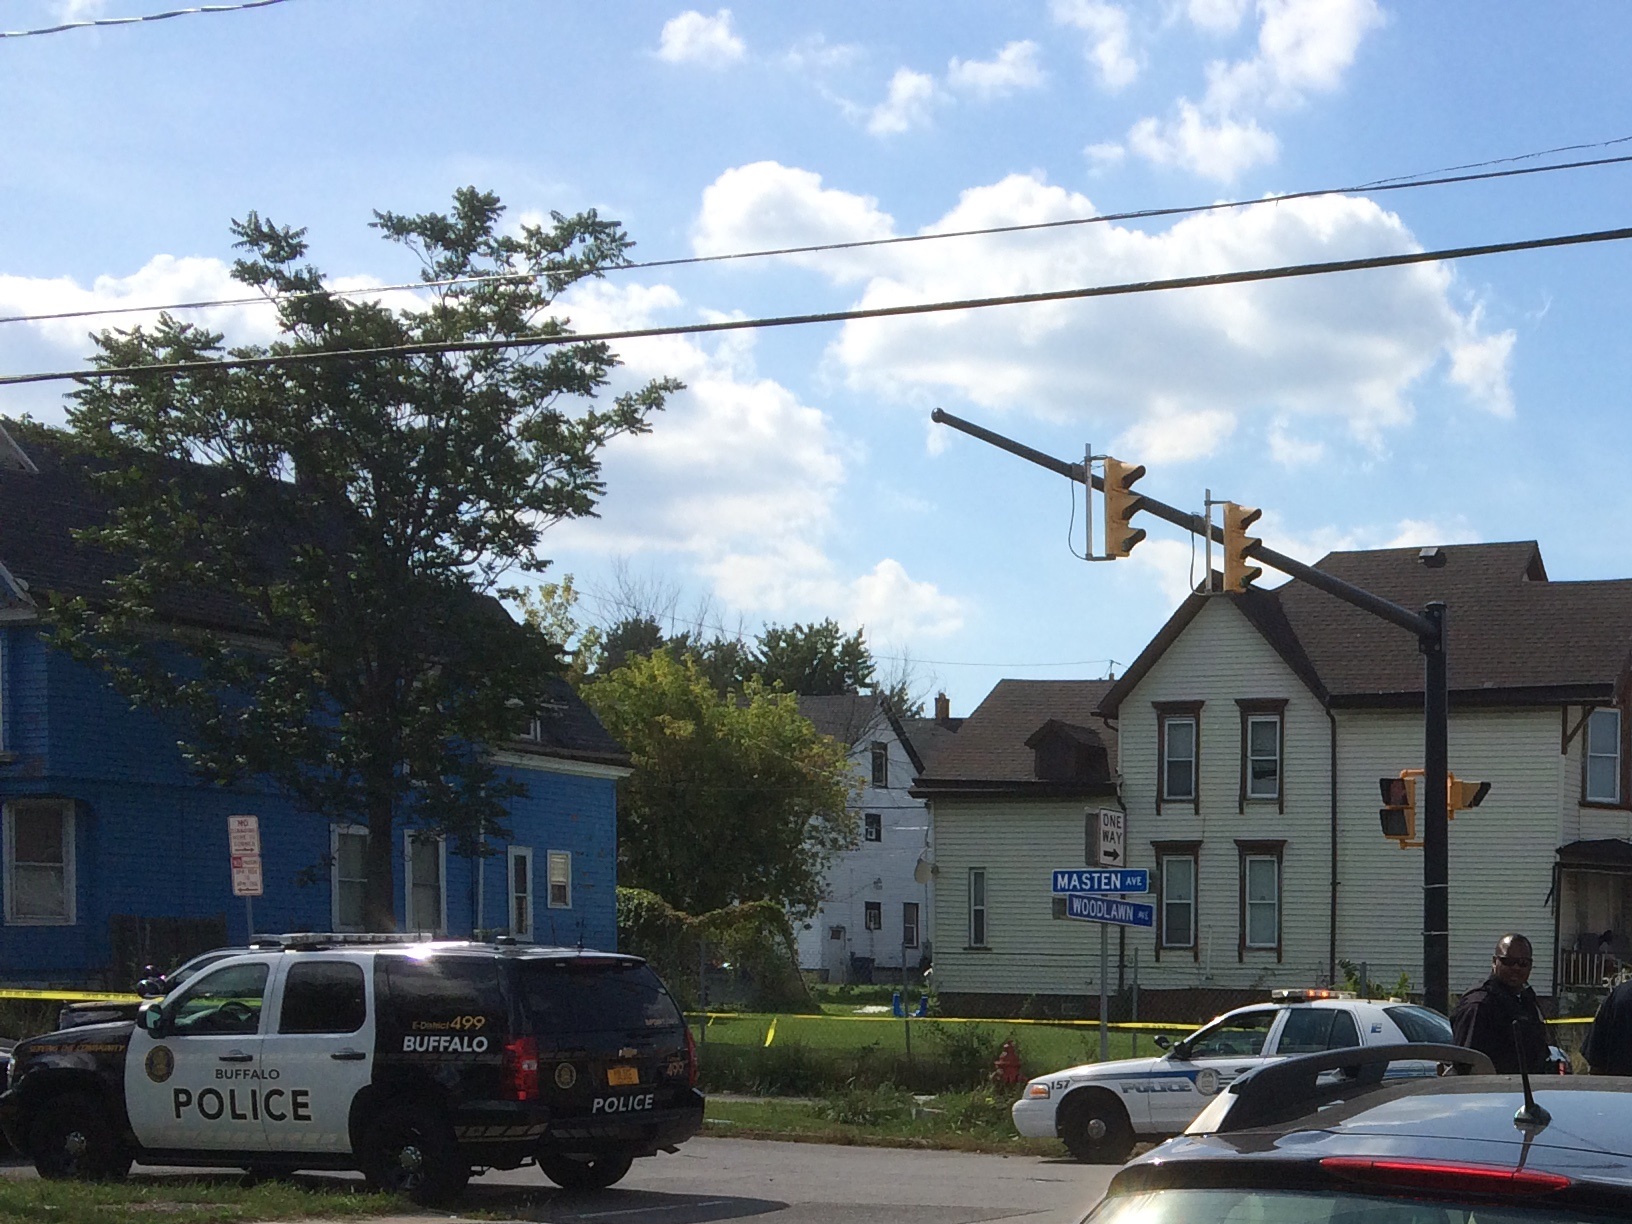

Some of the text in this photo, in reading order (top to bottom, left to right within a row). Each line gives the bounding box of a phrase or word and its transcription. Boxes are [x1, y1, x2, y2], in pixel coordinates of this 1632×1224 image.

[1103, 813, 1121, 829] ONE
[1103, 830, 1122, 844] WAY
[1057, 873, 1142, 890] MASTEN AVE
[1072, 897, 1134, 921] WOODLAWN
[450, 1015, 486, 1030] 499
[403, 1036, 488, 1052] BUFFALO
[215, 1069, 280, 1080] BUFFALO
[1051, 1079, 1070, 1090] 157
[1119, 1081, 1193, 1094] POLICE
[173, 1087, 312, 1122] POLICE
[592, 1094, 654, 1114] POLICE
